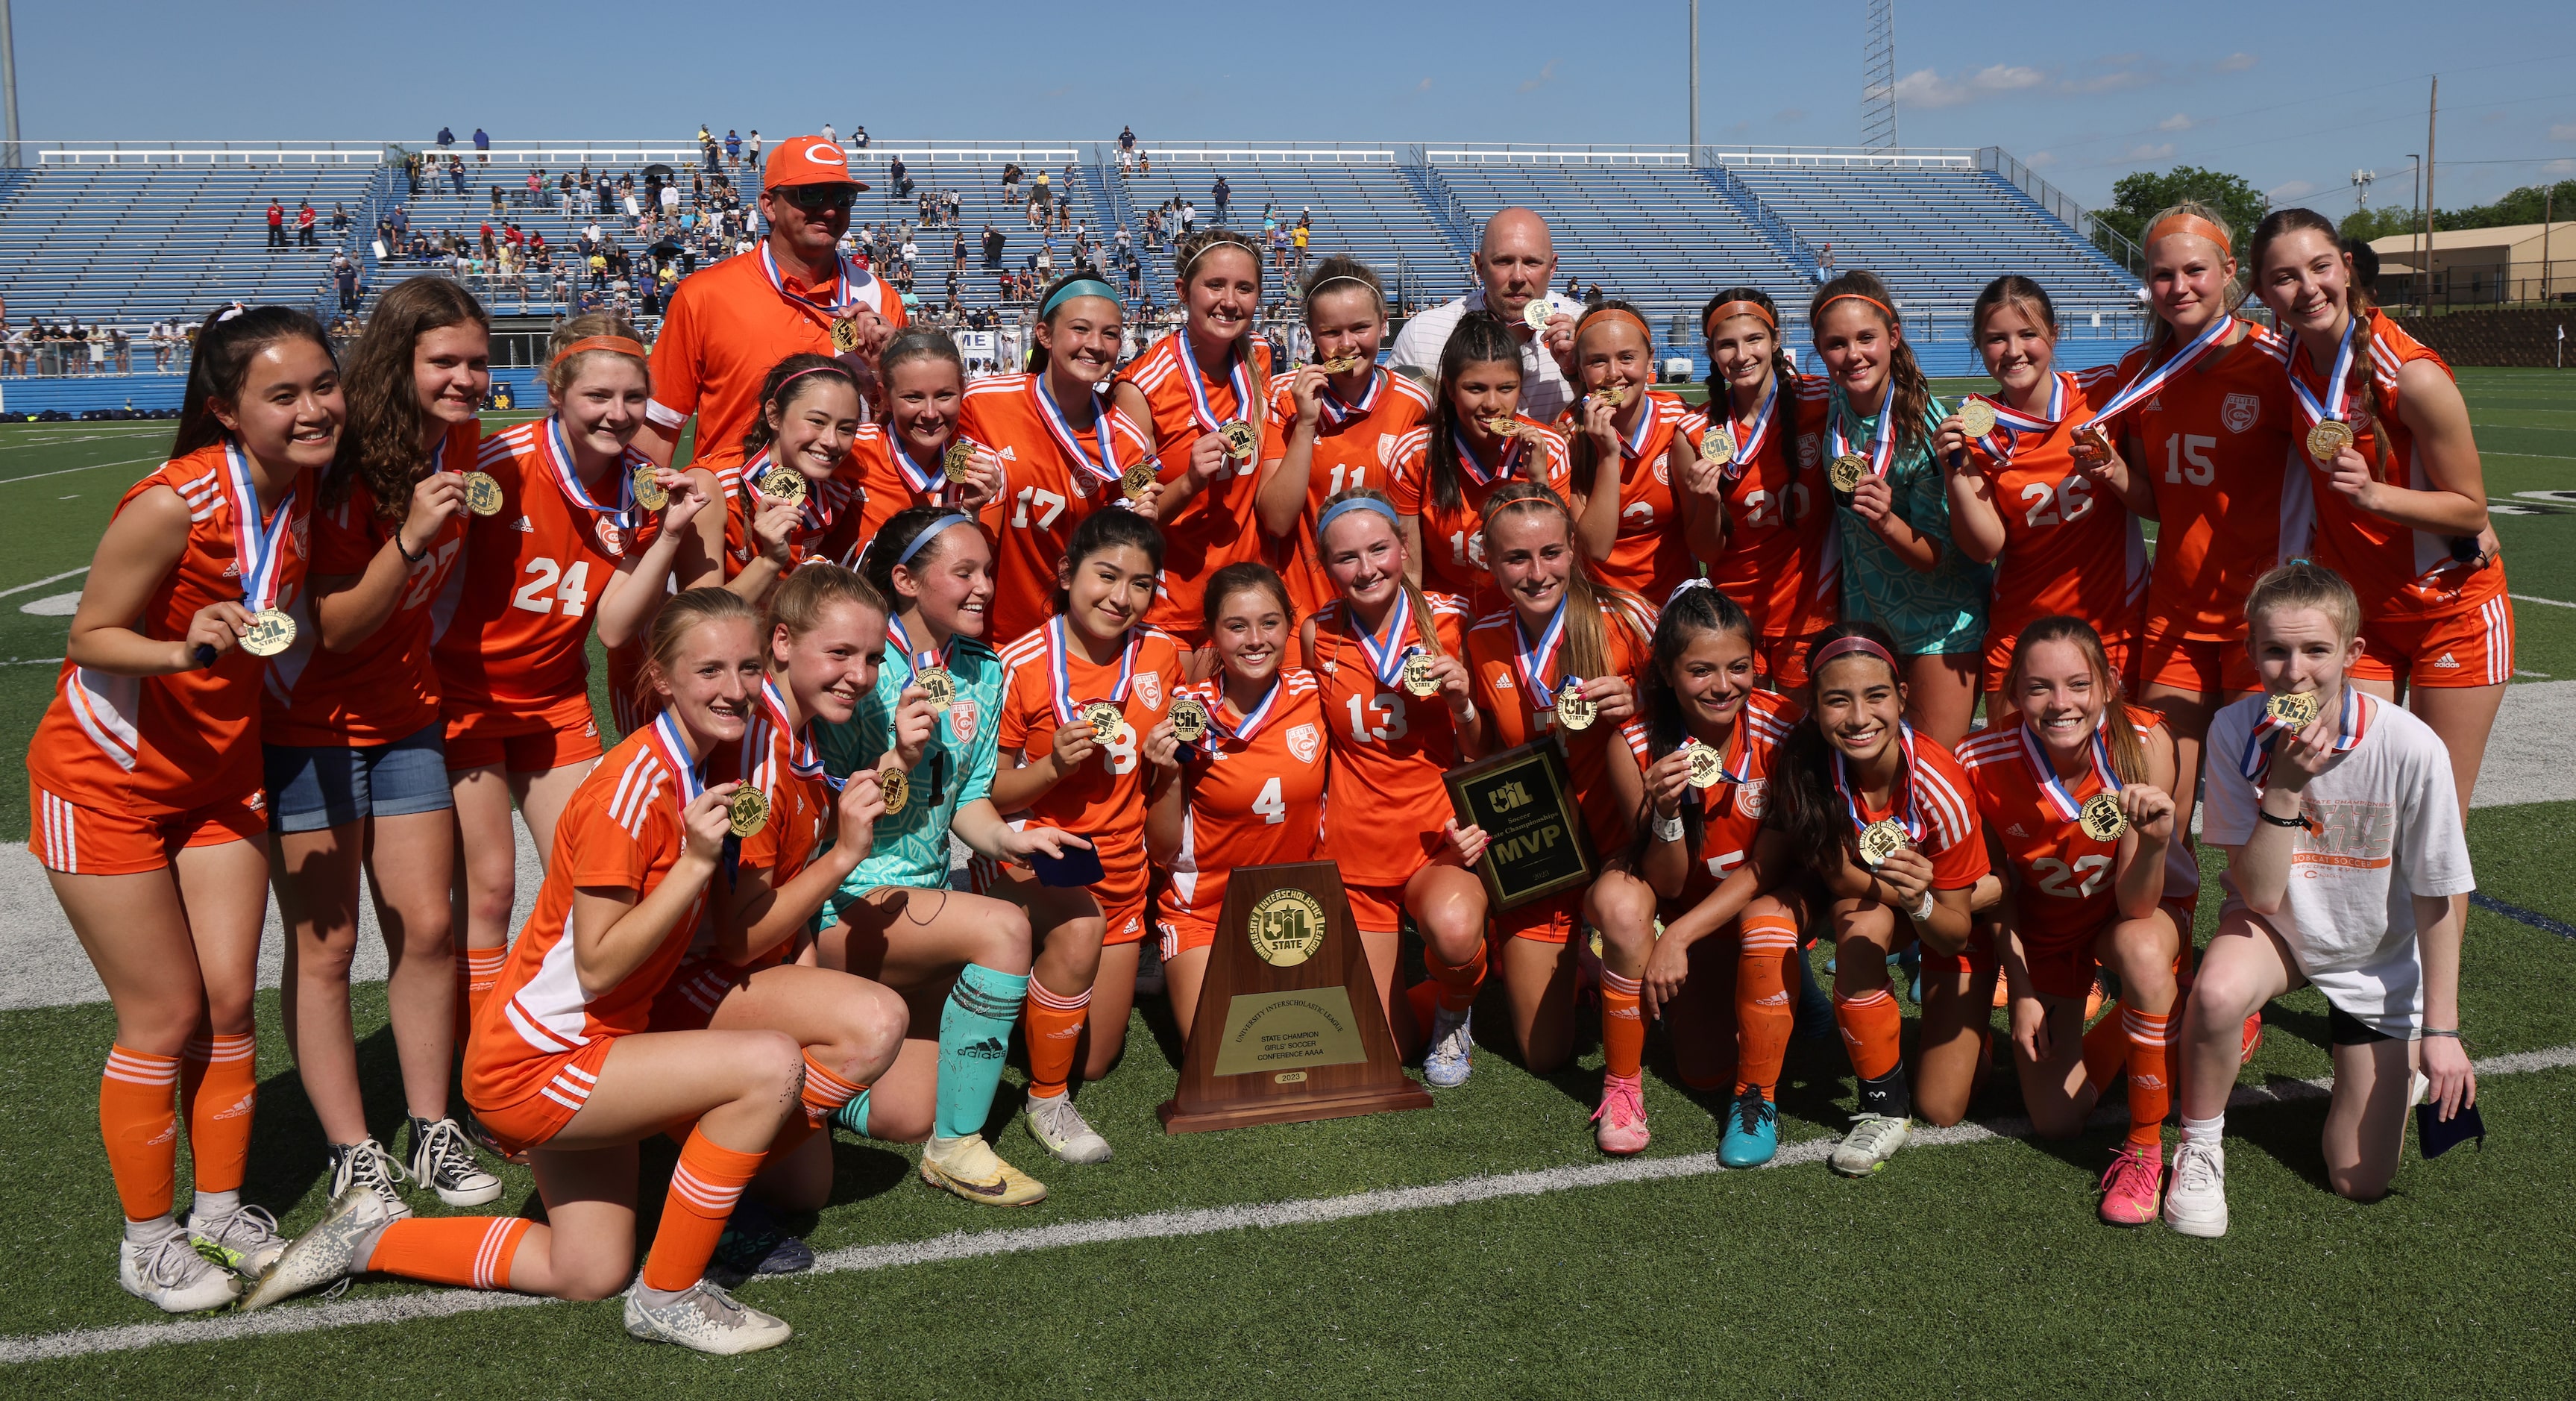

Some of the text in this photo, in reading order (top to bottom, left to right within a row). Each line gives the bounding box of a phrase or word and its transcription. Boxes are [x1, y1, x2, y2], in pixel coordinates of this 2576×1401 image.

[805, 144, 845, 166] C
[2228, 396, 2256, 406] CELINA
[2165, 433, 2217, 486] 15
[1325, 463, 1366, 501] 11
[1837, 476, 1852, 486] STATE
[1011, 486, 1066, 533] 17
[1744, 482, 1811, 528] 20
[2021, 474, 2094, 528] 26
[509, 524, 535, 533] adidas
[403, 536, 460, 610] 27
[512, 557, 590, 618] 24
[259, 636, 282, 647] STATE
[286, 623, 297, 645] LEAGUE
[917, 668, 954, 684] INTERSCHOLASTIC
[1137, 674, 1157, 683] CELINA
[929, 696, 945, 705] STATE
[952, 703, 974, 712] CELINA
[1107, 703, 1122, 720] LEAGUE
[1172, 701, 1207, 718] INTERSCHOLASTIC
[1346, 693, 1408, 742] 13
[1107, 718, 1116, 736] STATE
[1289, 727, 1313, 739] CELINA
[1104, 722, 1137, 775] 8
[1715, 753, 1723, 774] LEAGUE
[929, 750, 945, 809] 1
[1699, 768, 1715, 781] STATE
[1739, 781, 1767, 791] CELINA
[1251, 777, 1286, 824] 4
[744, 815, 761, 829] STATE
[1504, 812, 1559, 836] Championships
[1507, 812, 1531, 825] Soccer
[2080, 794, 2117, 842] UNIVERSITY LEAGUE
[2087, 815, 2102, 833] STATE
[1494, 824, 1561, 865] MVP
[1859, 822, 1877, 850] UNIVERSITY
[2293, 853, 2372, 868] BOBCAT SOCCER
[1533, 869, 1551, 881] 2023
[2030, 853, 2114, 899] 22
[1249, 889, 1325, 962] UNIVERSITY INTERSCHOLASTIC LEAGUE
[1272, 939, 1303, 950] STATE
[1235, 1000, 1344, 1044] UNIVERSITY INTERSCHOLASTIC LEAGUE
[1260, 1031, 1319, 1044] STATE CHAMPION
[1264, 1040, 1316, 1052] GIRLS' SOCCER
[957, 1047, 1007, 1060] adidas
[1257, 1048, 1325, 1062] CONFERENCE AAAA
[1282, 1073, 1301, 1082] 2023
